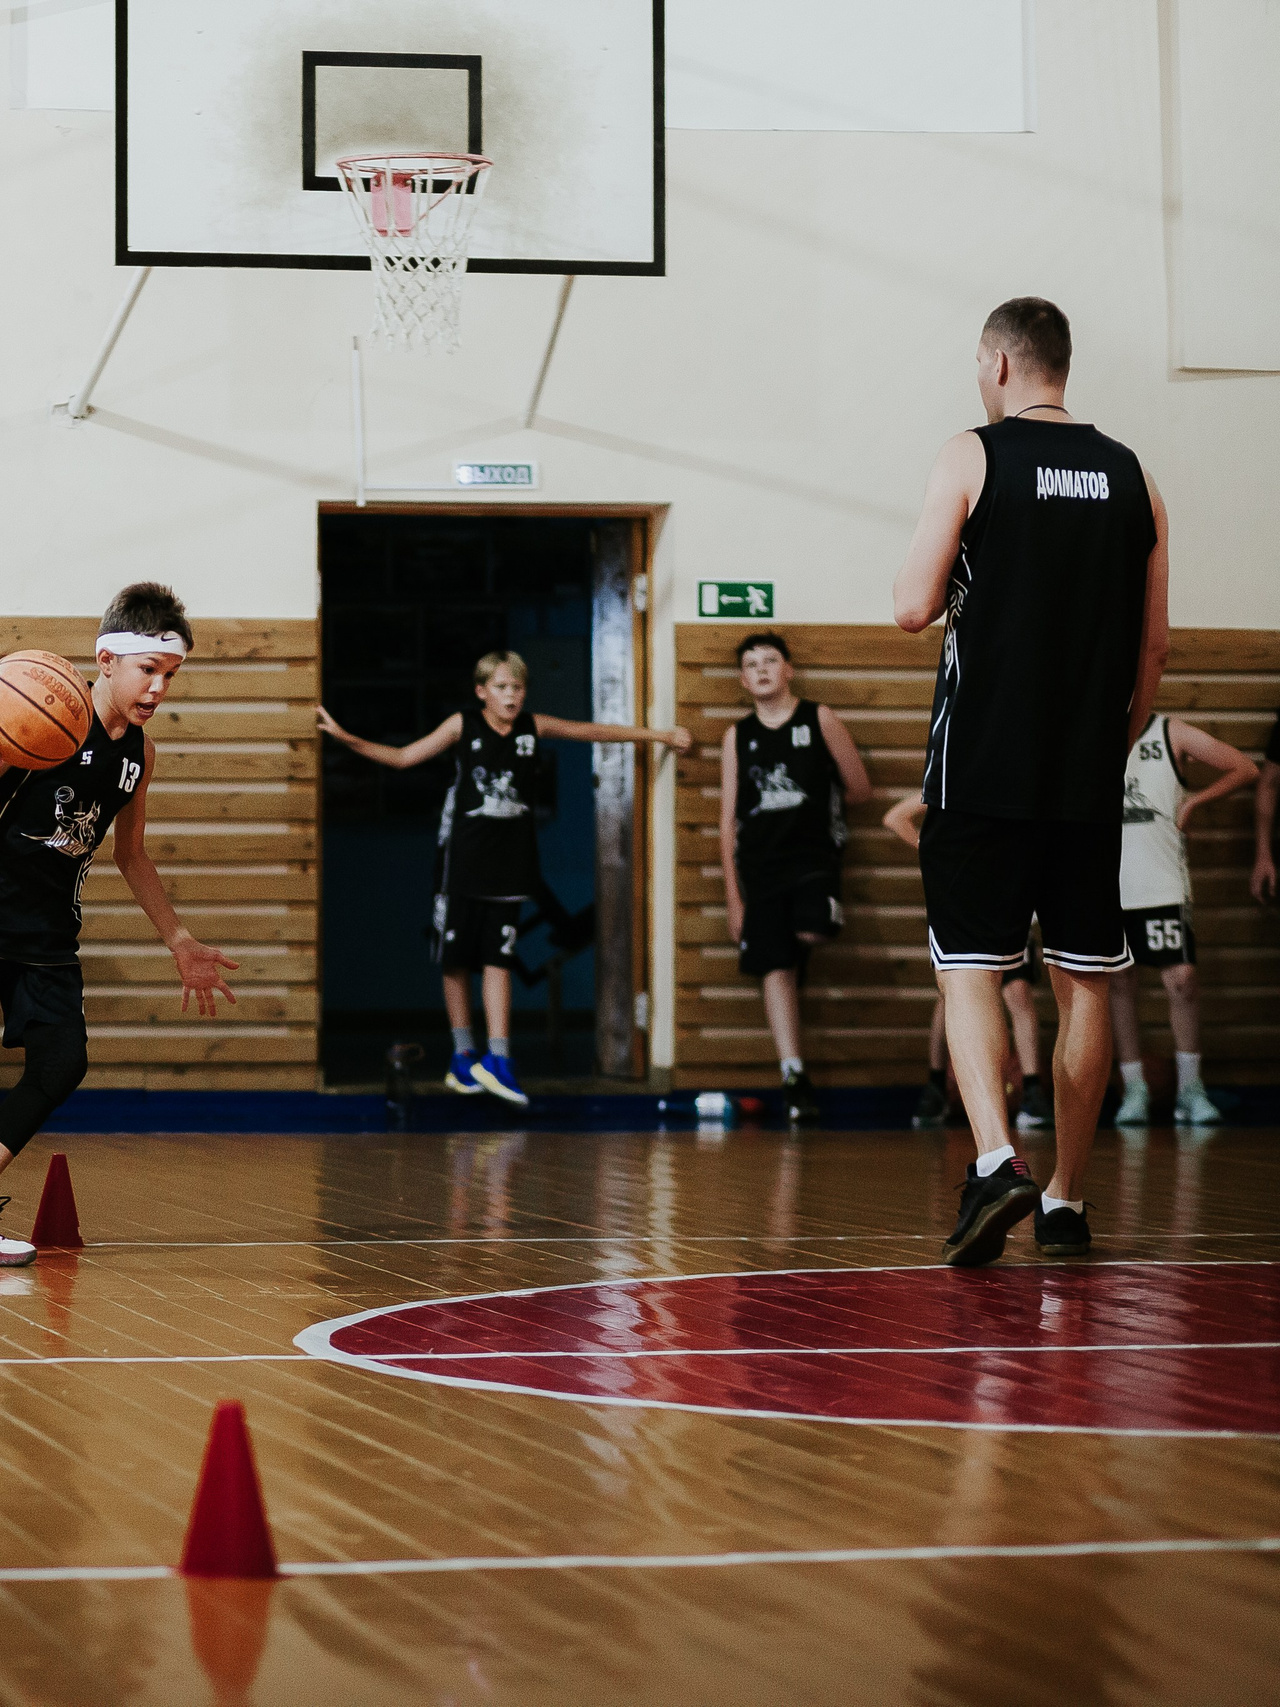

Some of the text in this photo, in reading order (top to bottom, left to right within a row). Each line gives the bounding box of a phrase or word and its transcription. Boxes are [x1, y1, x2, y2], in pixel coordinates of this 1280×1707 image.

[1037, 466, 1109, 500] ДОЛМАТОВ
[29, 666, 85, 721] TORRES
[1140, 741, 1163, 761] 55
[118, 757, 141, 793] 13
[1145, 919, 1181, 950] 55
